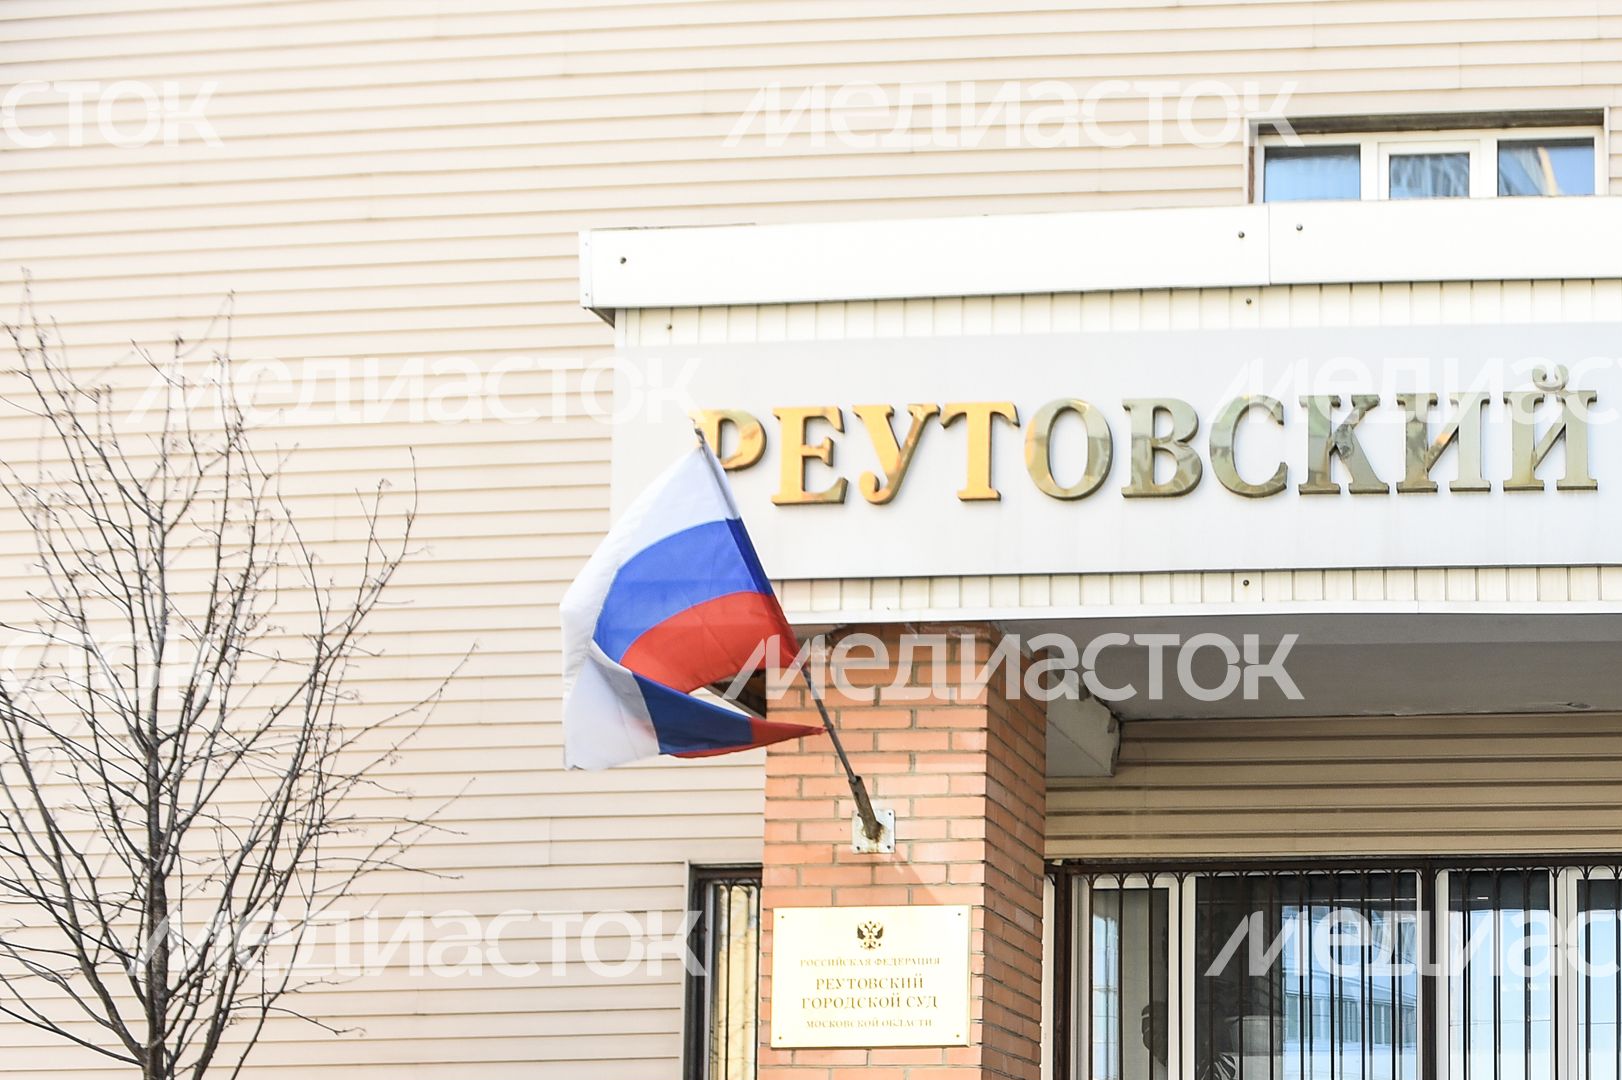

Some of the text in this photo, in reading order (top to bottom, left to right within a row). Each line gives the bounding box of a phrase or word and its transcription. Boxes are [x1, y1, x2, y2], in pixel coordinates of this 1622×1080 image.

[687, 363, 1598, 507] РЕУТОВСКИЙ
[800, 956, 940, 967] РОССИЙСКАЯ ФЕДЕРАЦИЯ
[816, 973, 923, 990] РЕУТОВСКИЙ
[802, 992, 938, 1009] ГОРОДСКОЙ СУД
